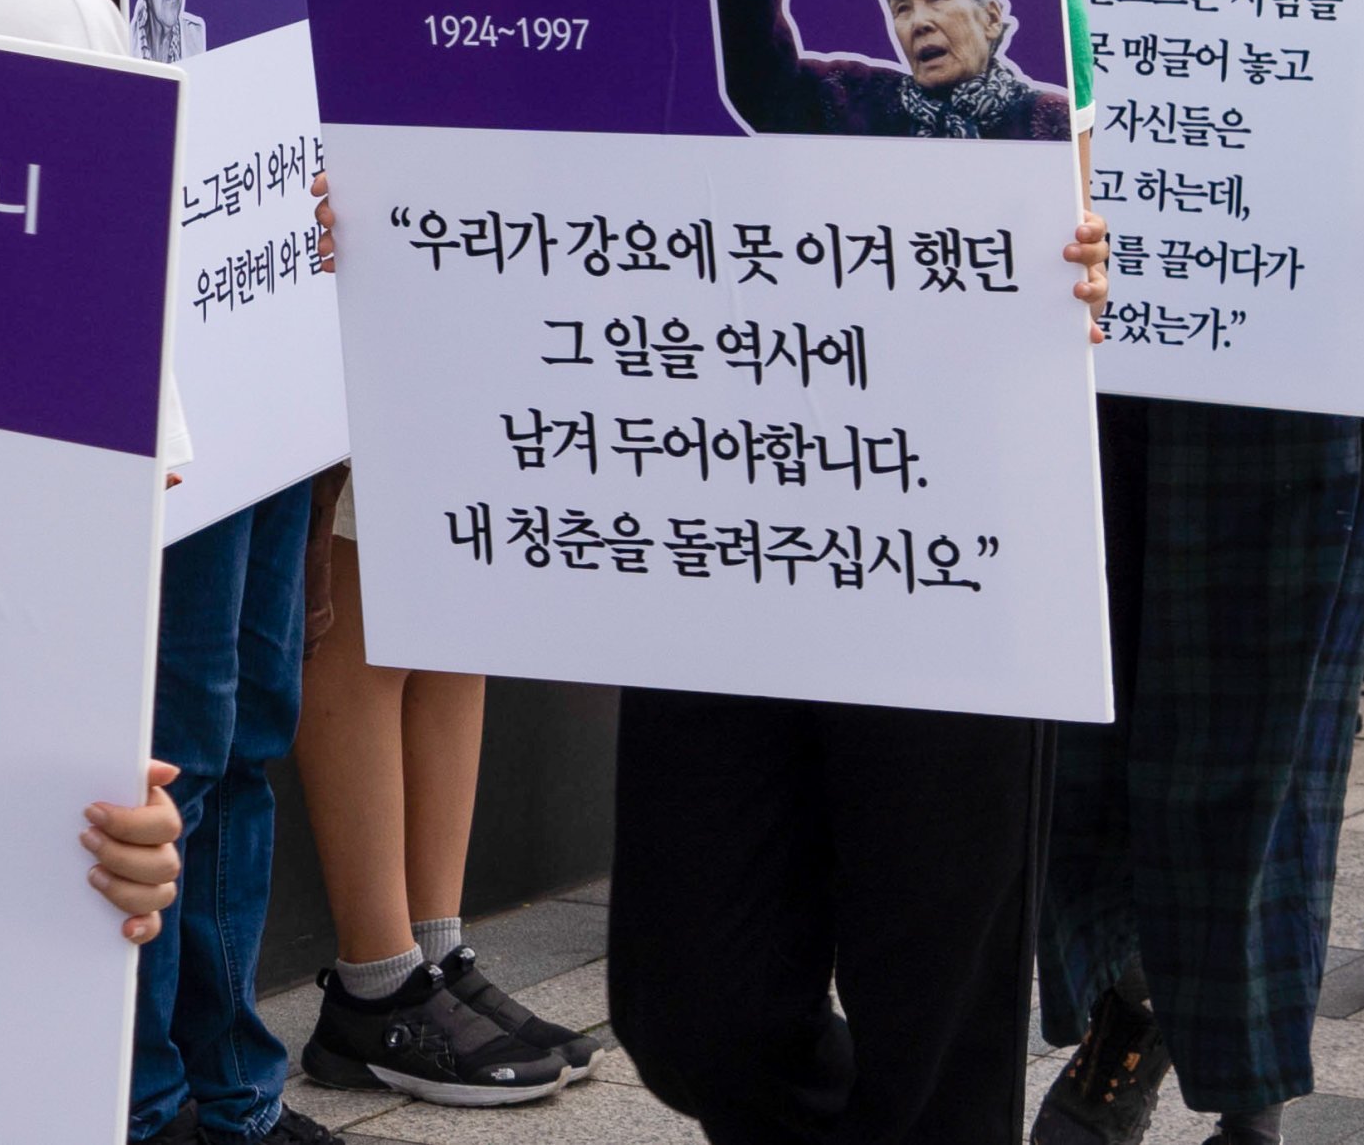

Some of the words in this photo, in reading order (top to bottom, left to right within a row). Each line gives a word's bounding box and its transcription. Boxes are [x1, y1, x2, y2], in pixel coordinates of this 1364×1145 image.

[425, 14, 589, 52] 1924~1997
[1122, 33, 1229, 83] 맹글어
[1238, 42, 1314, 85] 놓고
[1104, 99, 1251, 149] 자신들은
[267, 136, 305, 198] 와서
[1090, 169, 1128, 202] 고
[193, 240, 274, 322] 우리한테
[280, 232, 300, 286] 와
[567, 215, 717, 285] 강요에
[731, 225, 781, 285] 못
[796, 223, 895, 293] 이겨
[913, 227, 1020, 297] 했던
[1106, 234, 1150, 276] 를
[1157, 239, 1305, 291] 끌어다가
[542, 318, 594, 369] 그
[602, 317, 704, 381] 일을
[715, 320, 868, 390] 역사에
[500, 410, 600, 474] 남겨
[609, 418, 928, 493] 두어야합니다.
[445, 502, 493, 566] 내
[505, 508, 655, 576] 청춘을
